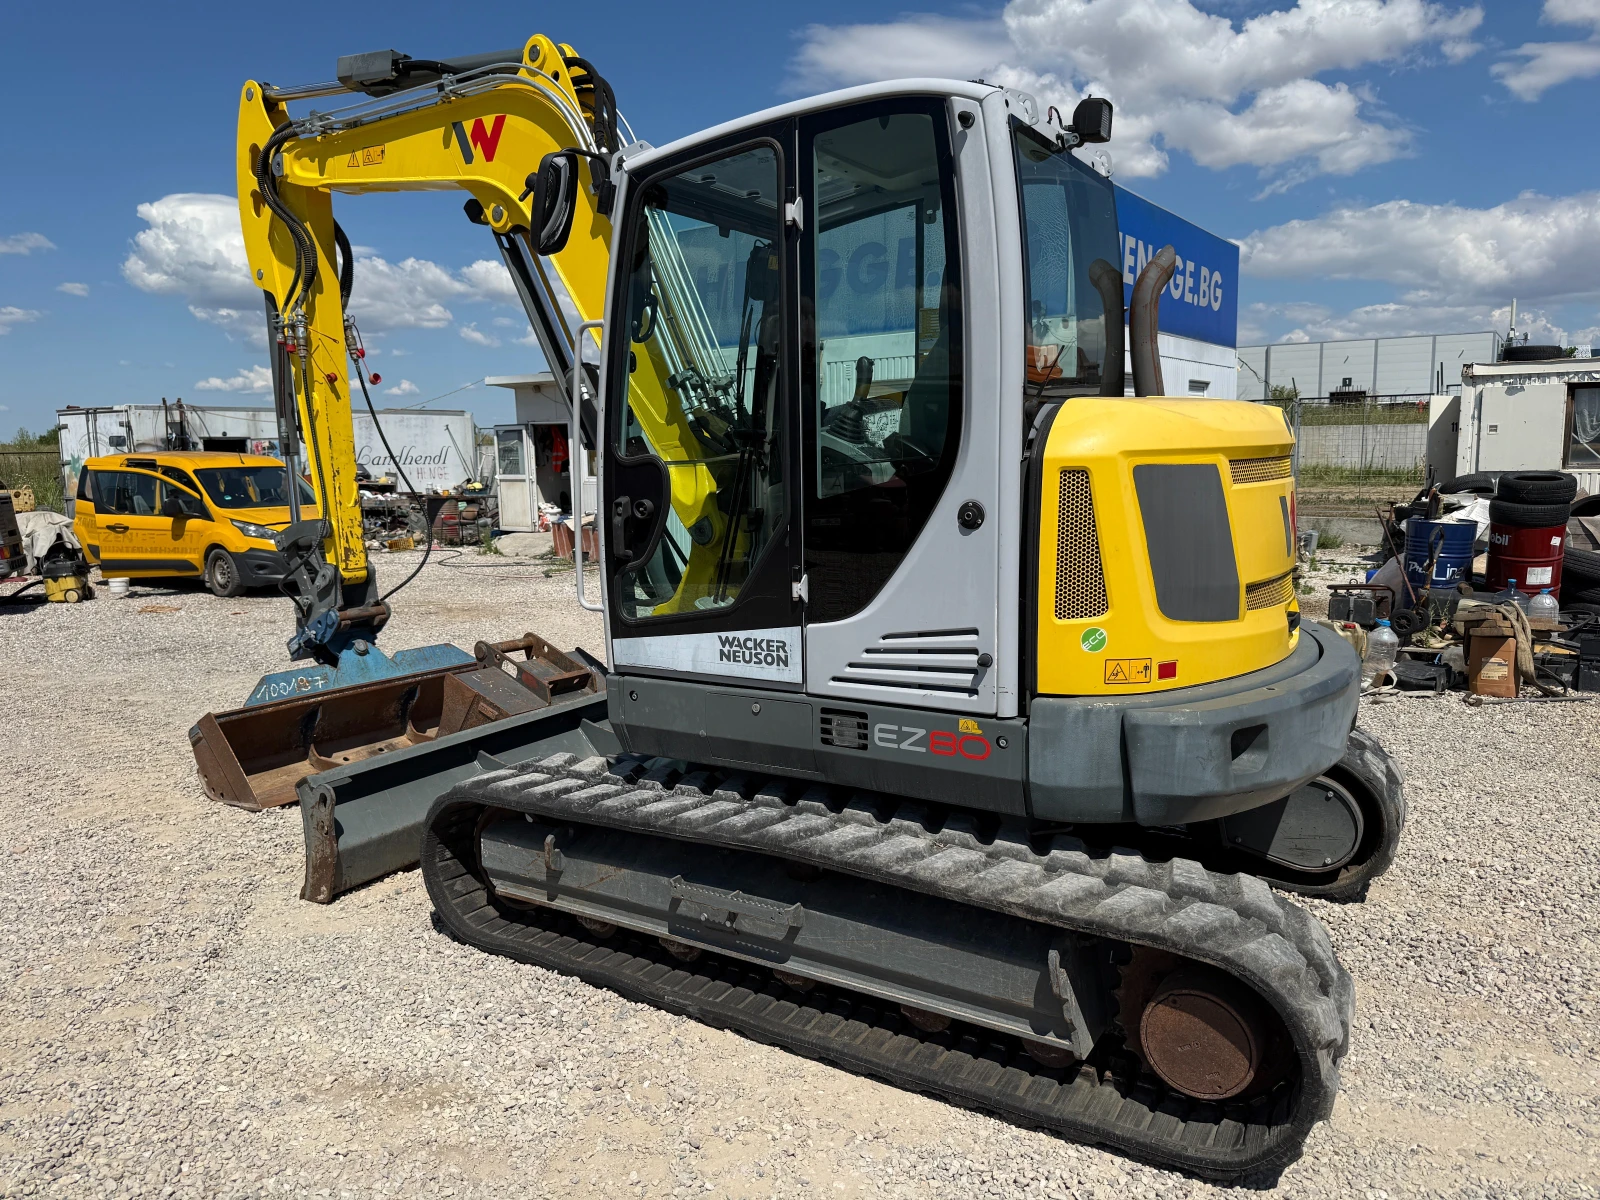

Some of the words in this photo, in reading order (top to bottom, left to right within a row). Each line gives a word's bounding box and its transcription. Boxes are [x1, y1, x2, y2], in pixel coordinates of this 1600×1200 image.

[1490, 533, 1509, 546] obil
[717, 635, 788, 654] WACKER
[1083, 629, 1106, 651] ECO
[719, 649, 789, 667] NEUSON
[874, 723, 991, 760] EZ80
